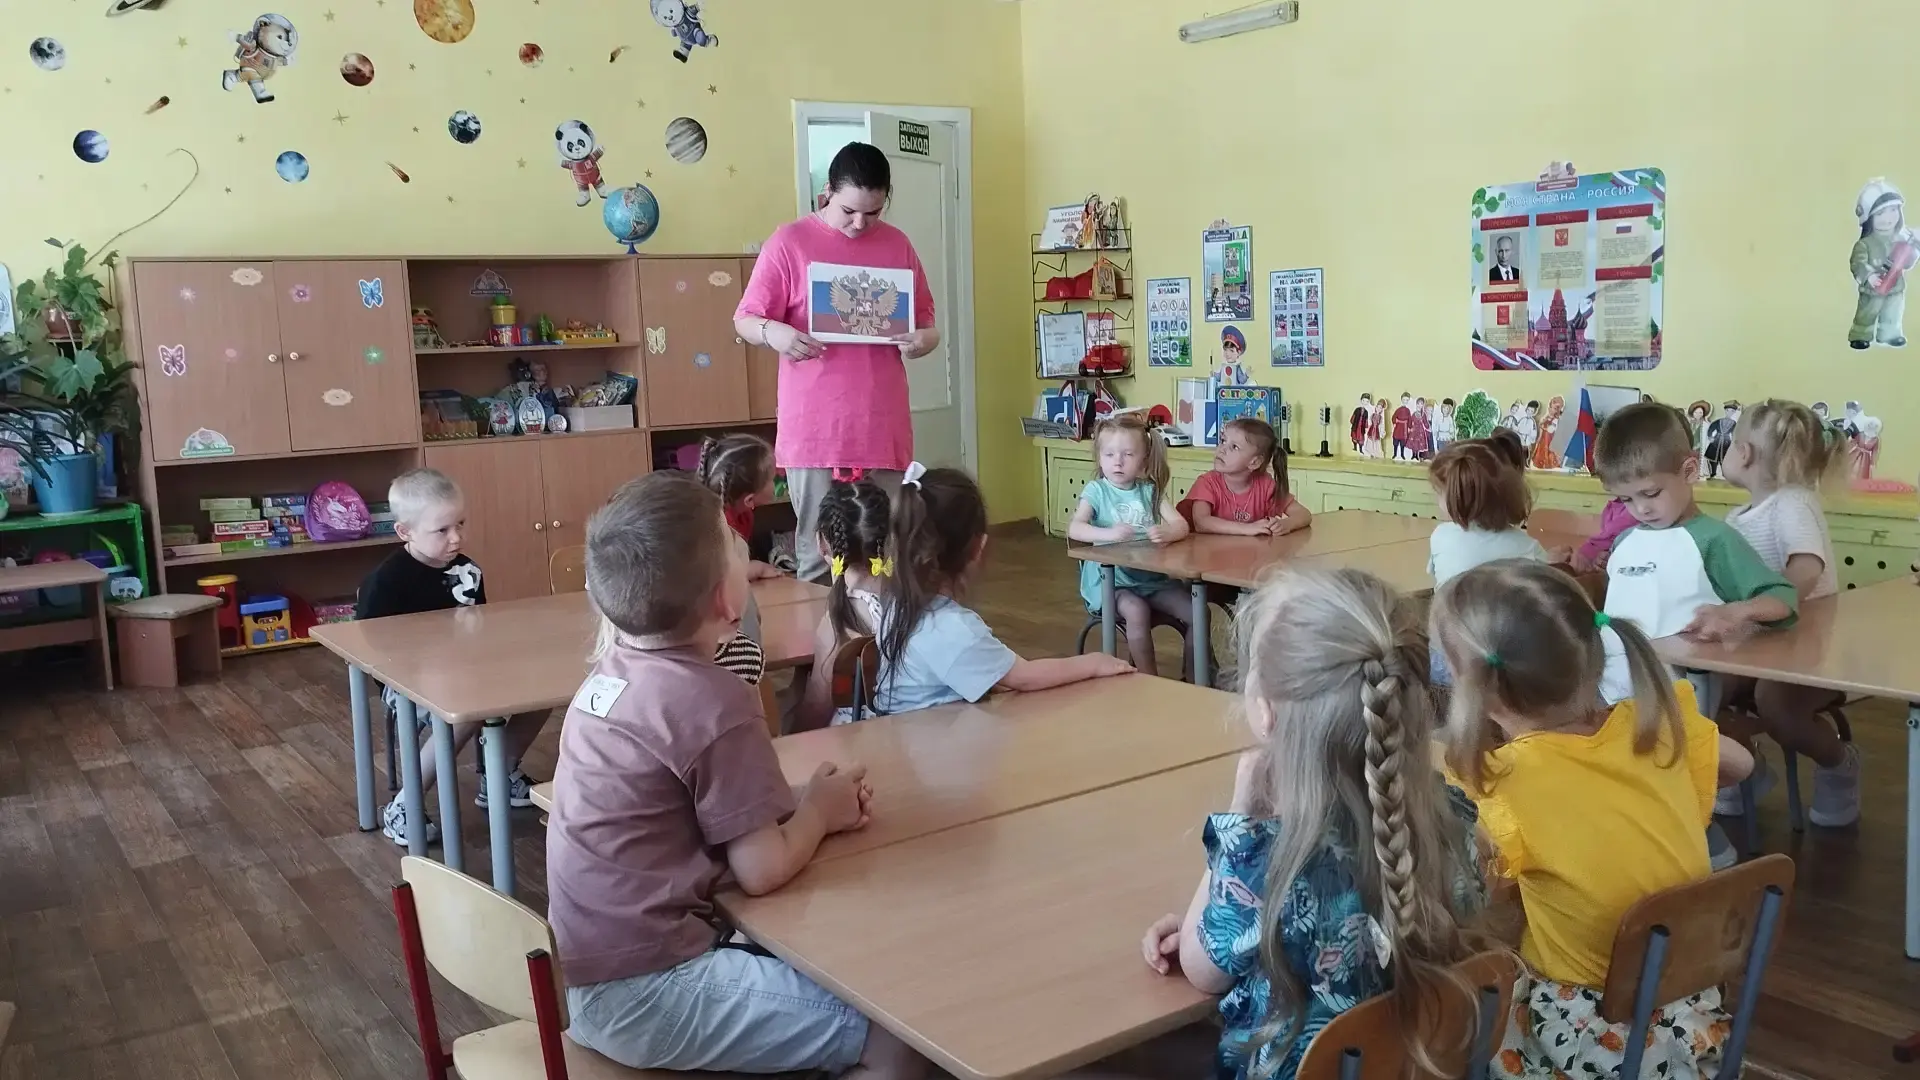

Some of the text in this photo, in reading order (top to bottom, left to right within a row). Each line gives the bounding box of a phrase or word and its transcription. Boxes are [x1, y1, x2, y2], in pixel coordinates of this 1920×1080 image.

[900, 123, 929, 136] ЗАПАСНЫЙ
[900, 134, 929, 155] ВЫХОД
[1587, 185, 1635, 199] РОССИЯ
[1220, 389, 1267, 399] СВЕТОФОР
